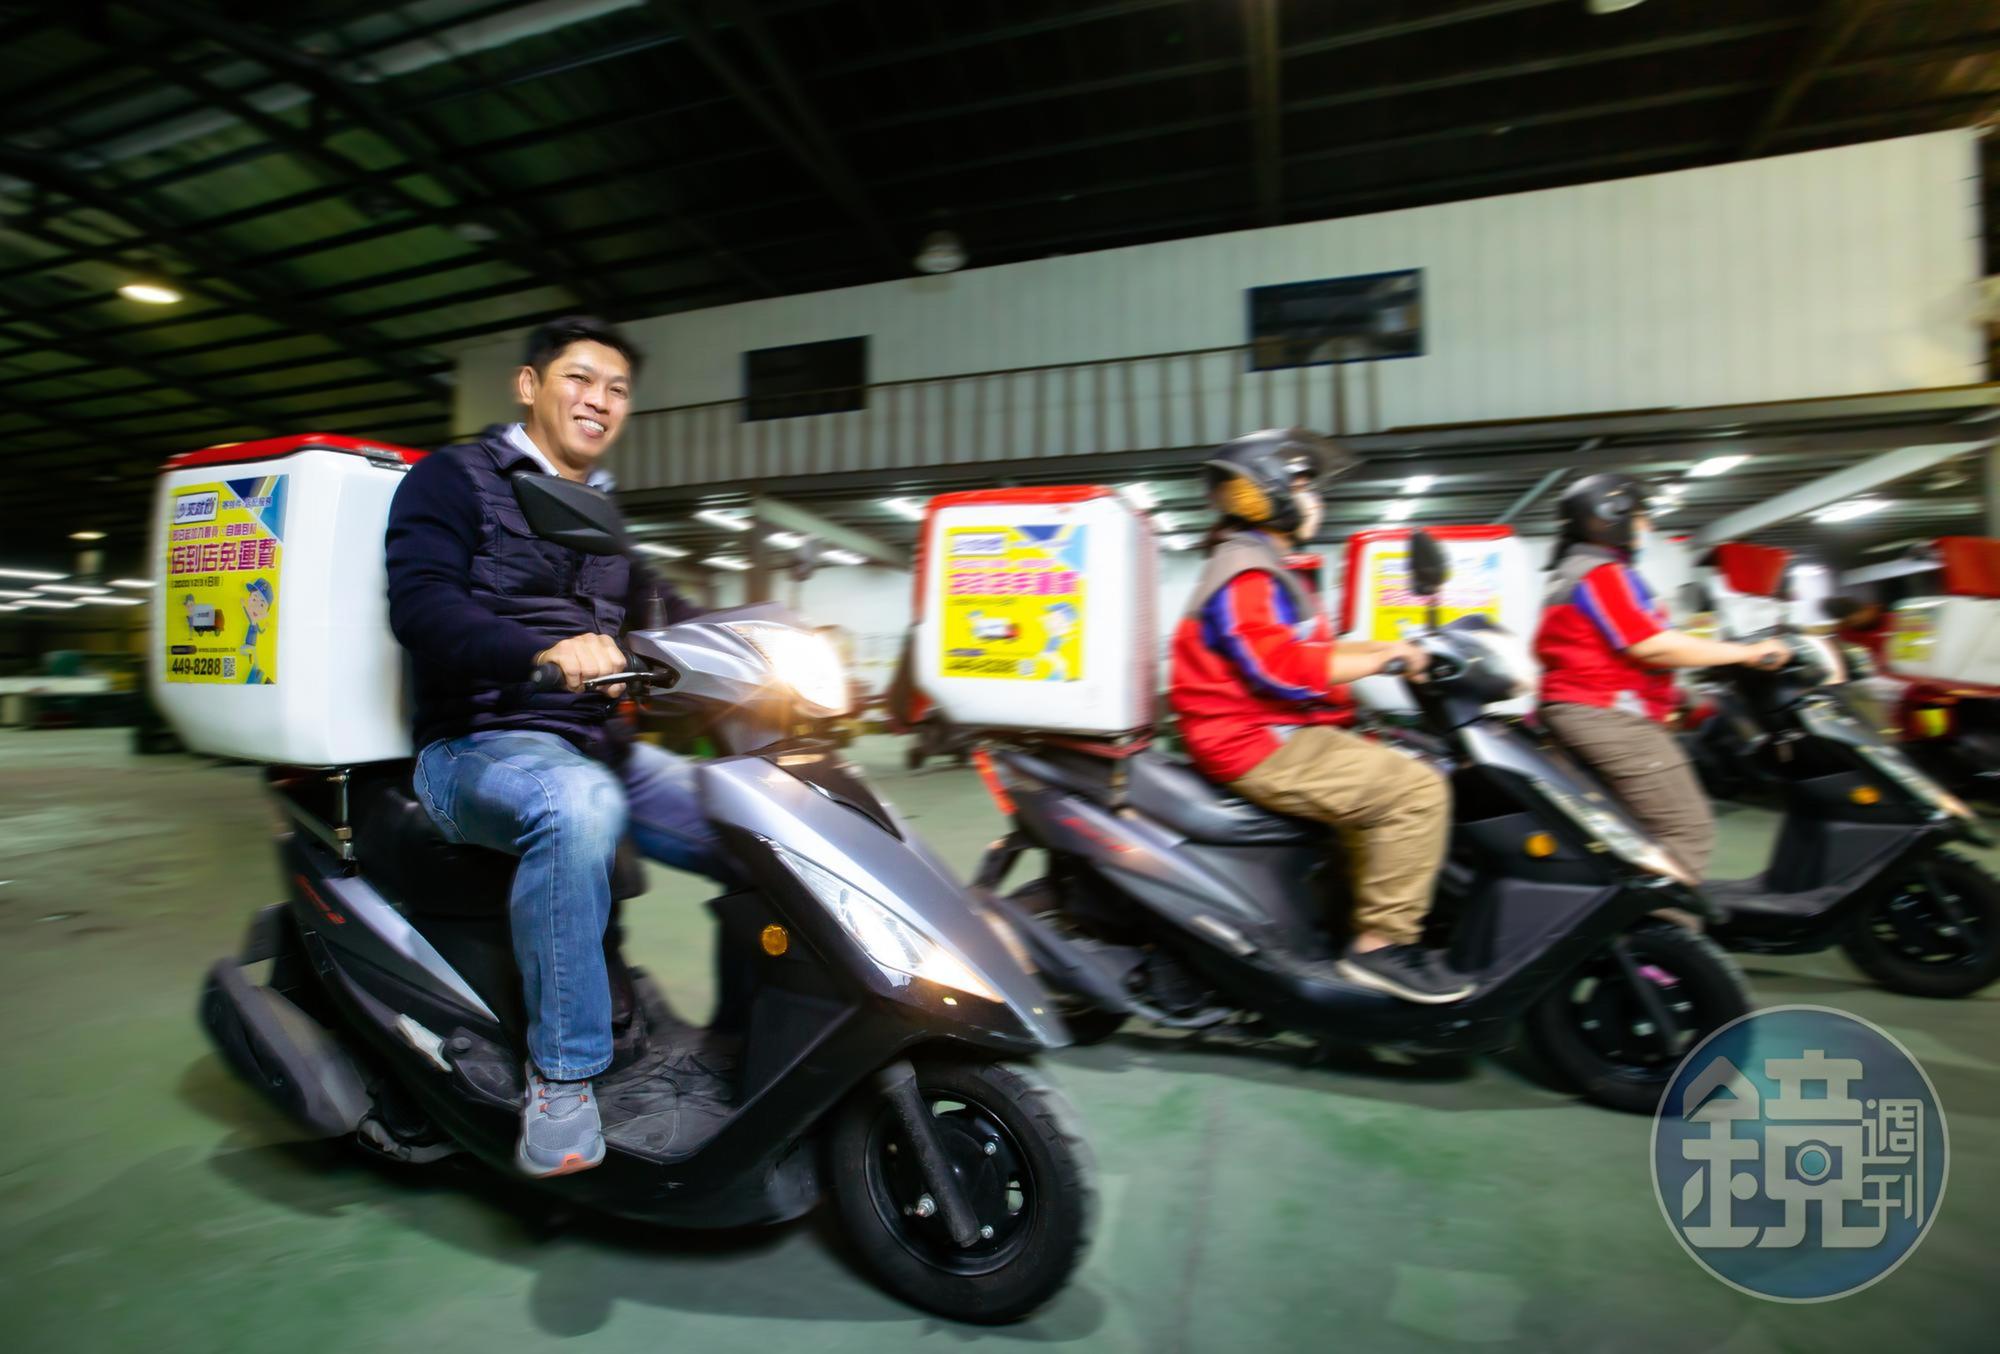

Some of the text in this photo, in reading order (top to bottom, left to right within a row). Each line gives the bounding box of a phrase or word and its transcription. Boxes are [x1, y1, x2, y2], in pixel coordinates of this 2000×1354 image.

[171, 538, 277, 574] 店到店免運費
[172, 657, 222, 675] 449-8288
